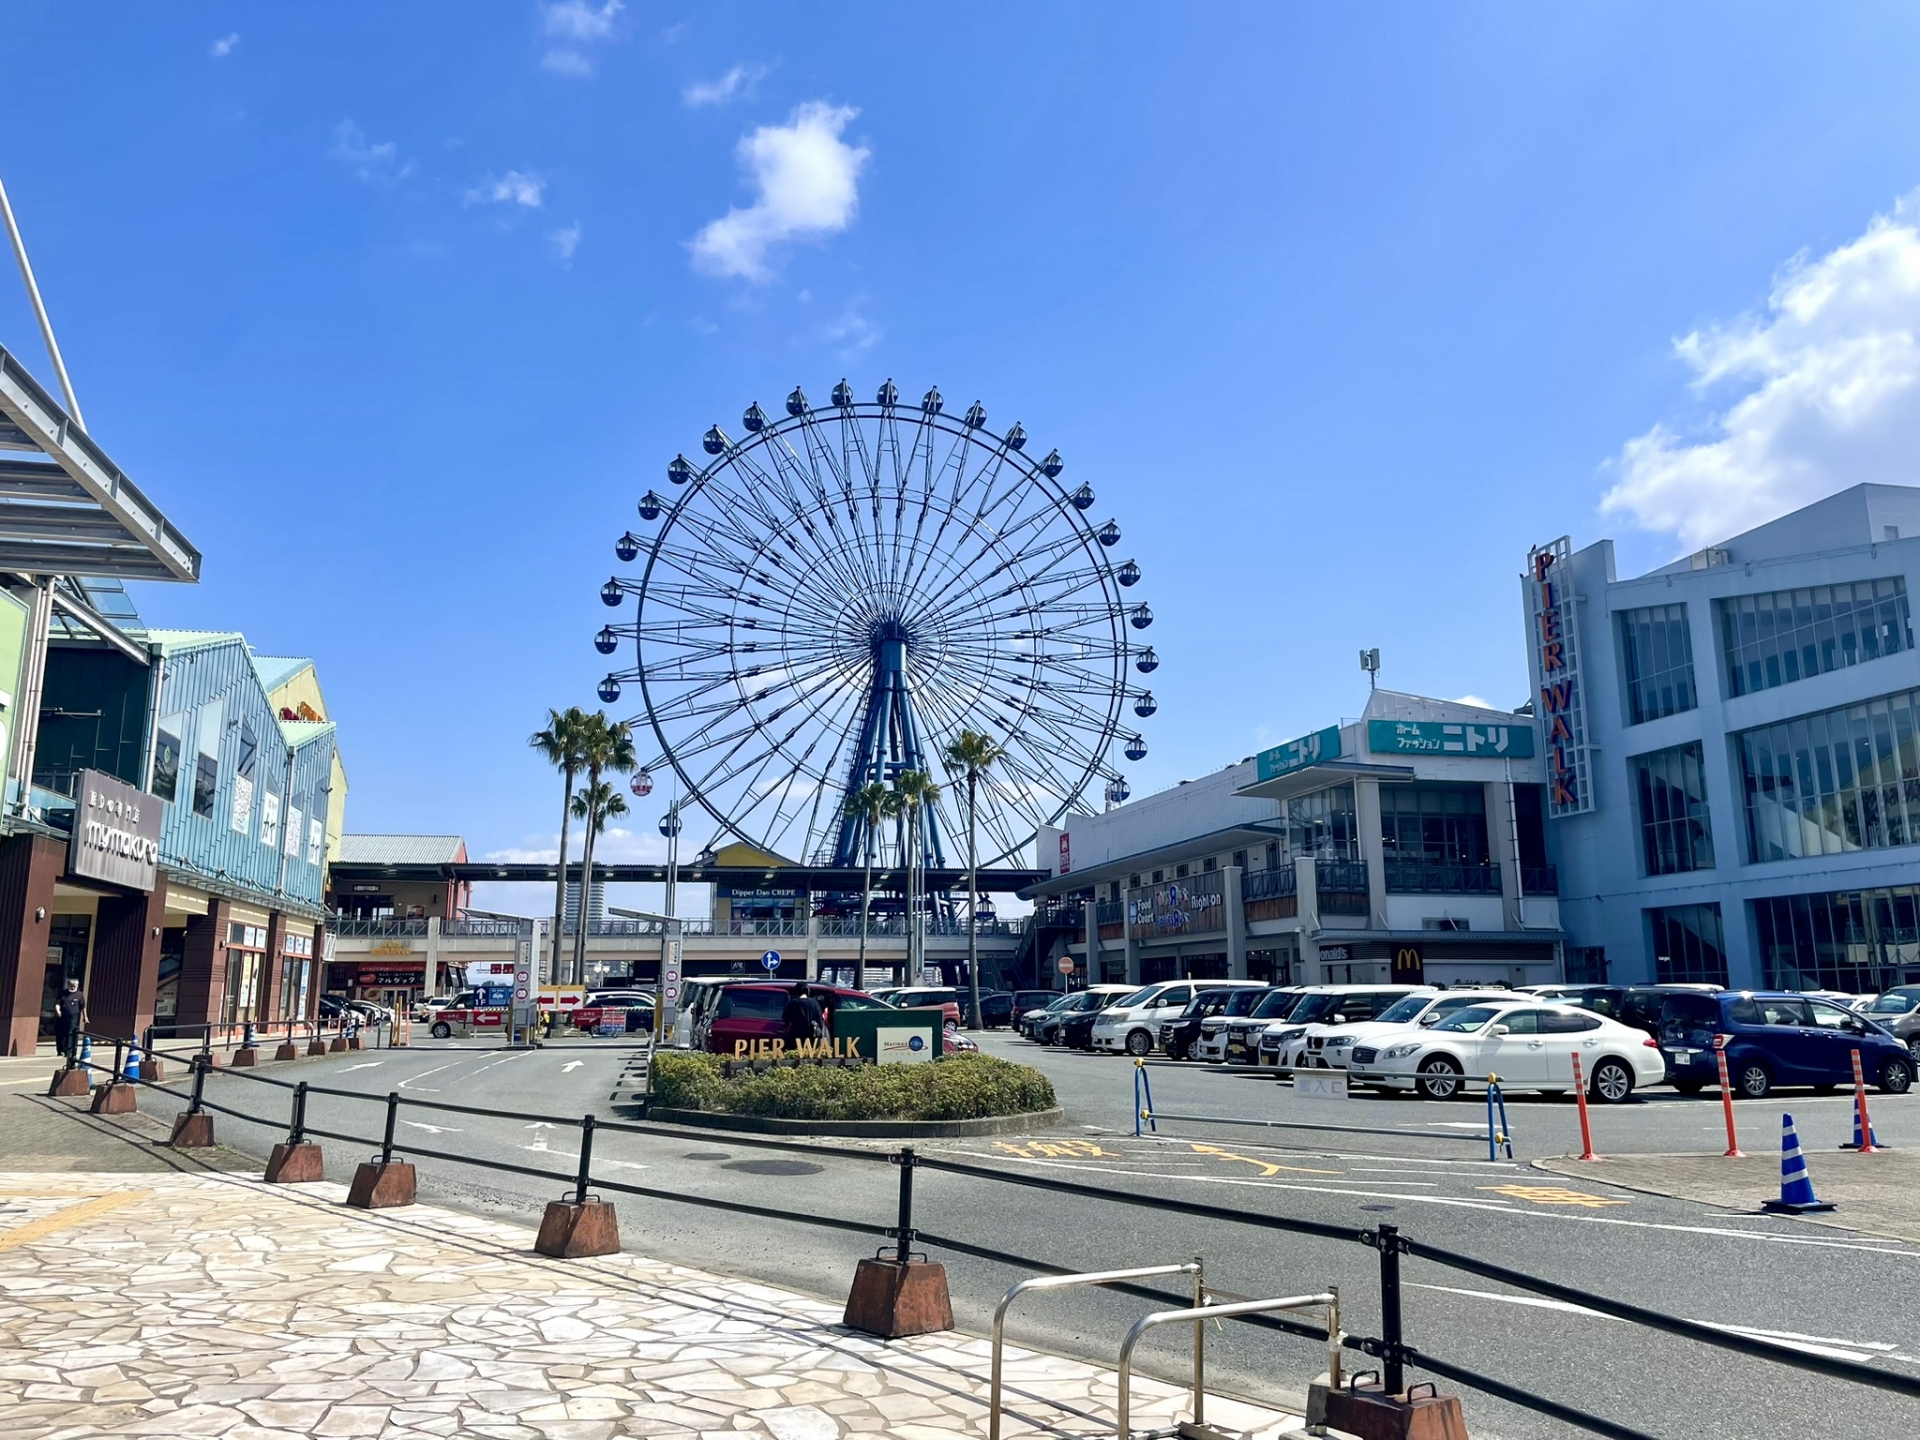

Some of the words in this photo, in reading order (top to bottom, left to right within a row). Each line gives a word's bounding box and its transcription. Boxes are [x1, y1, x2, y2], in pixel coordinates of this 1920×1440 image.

[1535, 552, 1566, 673] PIER
[1396, 723, 1420, 735] ホーム
[1397, 738, 1440, 749] ファッション
[1443, 725, 1509, 753] ニトリ
[1541, 680, 1578, 806] WALK
[1288, 735, 1321, 768] ニトリ
[732, 889, 755, 898] Dipper
[1137, 898, 1152, 911] Food
[1137, 913, 1154, 924] Court
[1320, 947, 1348, 961] onald's
[734, 1038, 785, 1060] PIER
[795, 1037, 861, 1060] WALK
